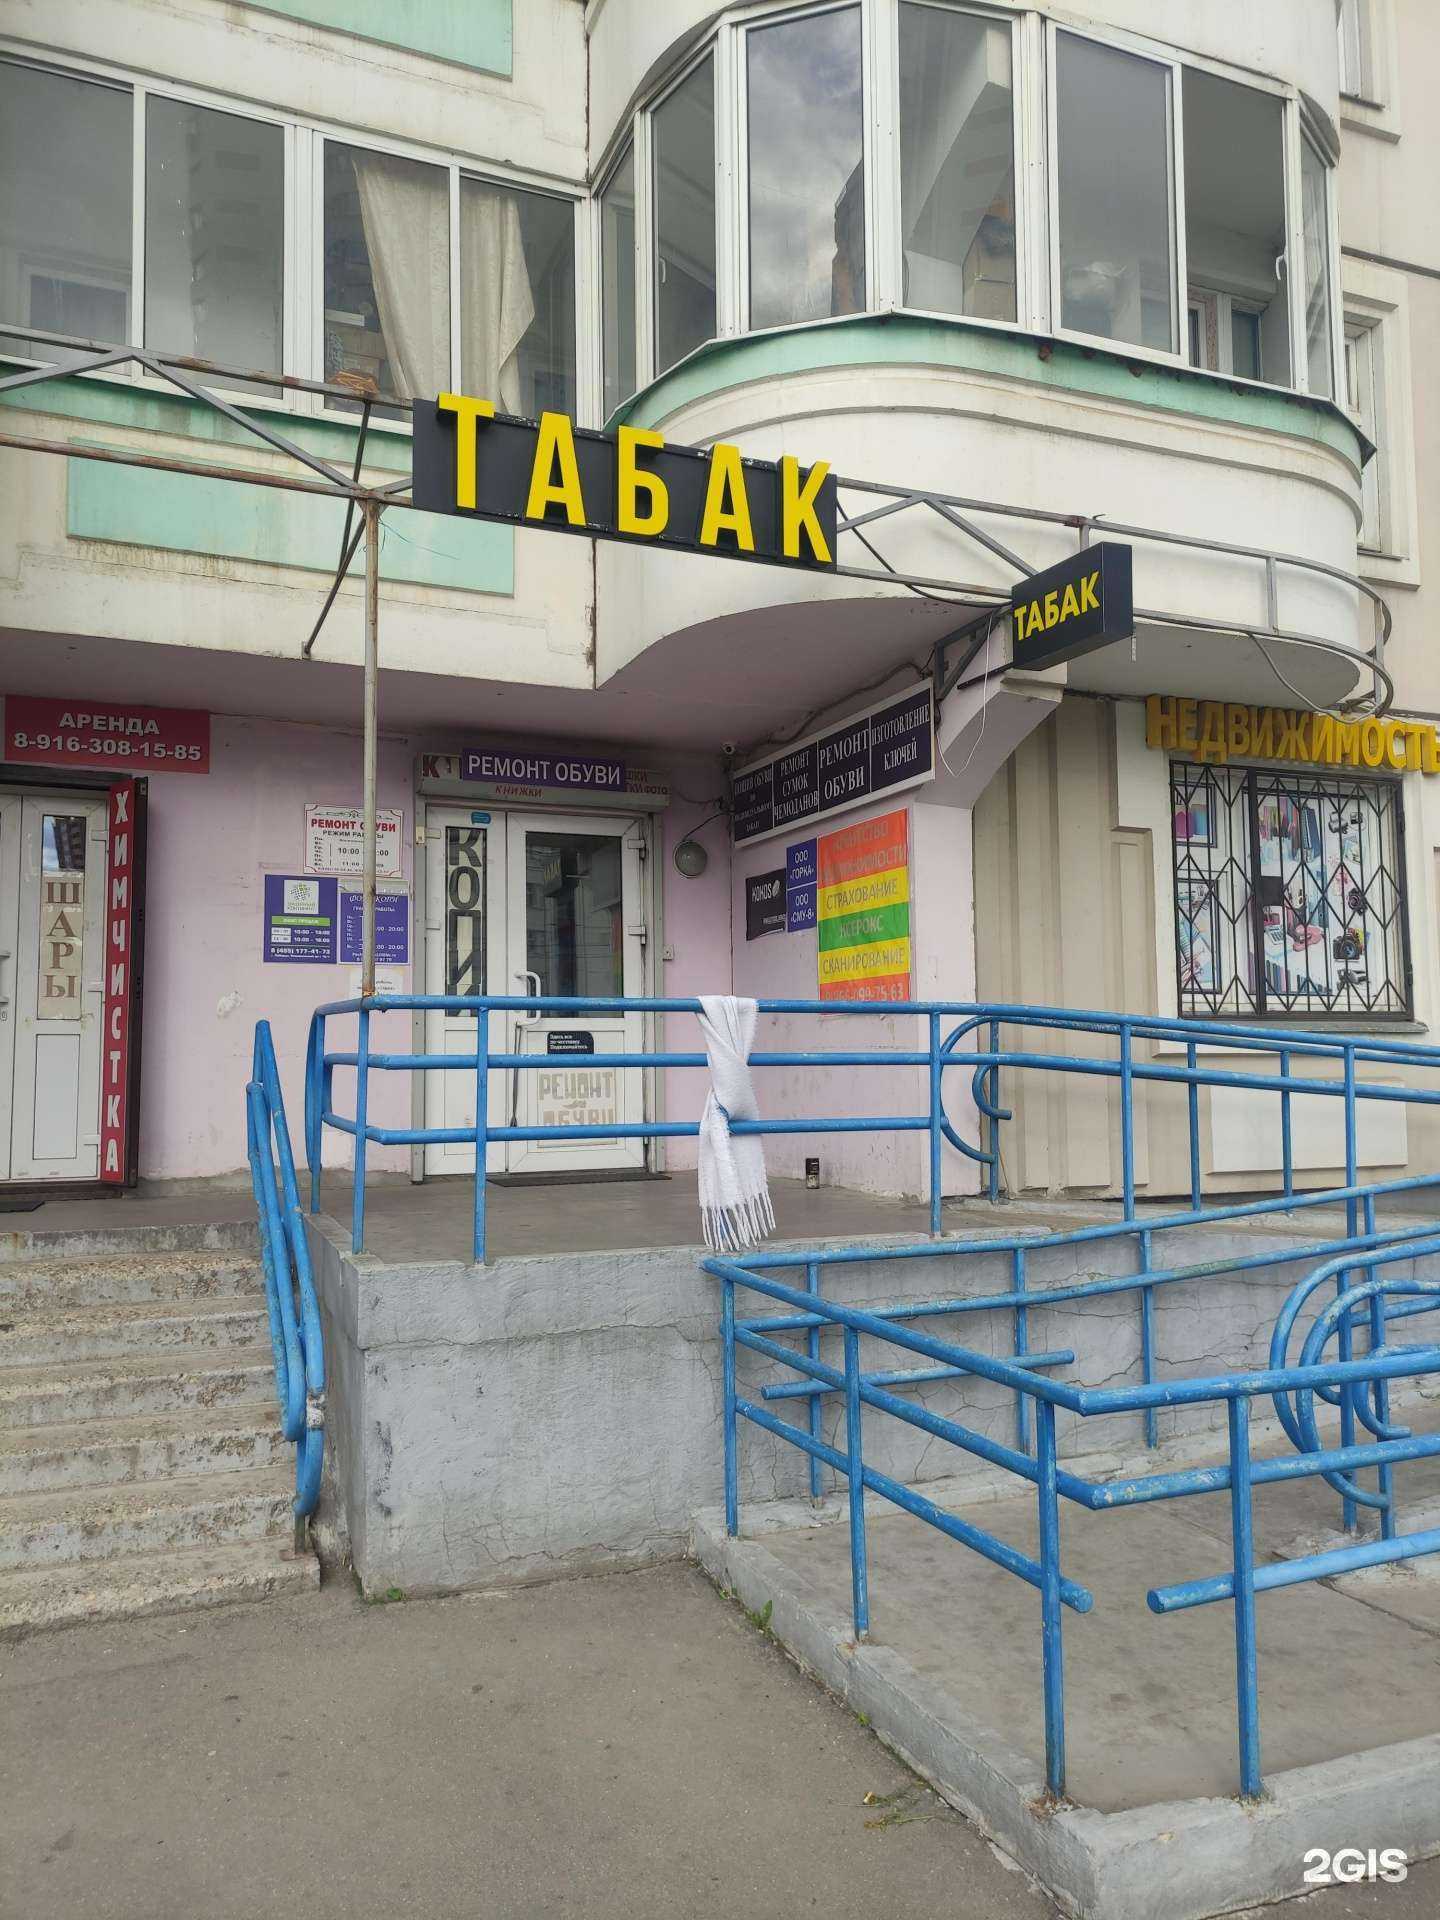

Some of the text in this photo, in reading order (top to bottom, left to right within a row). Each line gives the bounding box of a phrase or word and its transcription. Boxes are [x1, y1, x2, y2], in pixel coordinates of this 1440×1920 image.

[437, 393, 832, 563] ТАБАК
[1013, 571, 1101, 641] ТАБАК
[58, 712, 160, 736] АРЕНДА
[871, 703, 930, 746] ИЗГОТОВЛЕНИЕ
[1145, 695, 1440, 774] НЕДВИЖИМОСТЬ
[13, 732, 202, 761] 8-916-308-15-85
[819, 729, 870, 769] РЕМОНТ
[883, 737, 918, 771] КЛЮЧЕЙ
[468, 755, 621, 785] РЕМОНТ ОБУВИ
[780, 750, 809, 777] РЕМОНТ
[782, 773, 809, 797] СУМОК
[824, 766, 865, 800] ОБУВИ
[773, 790, 818, 821] ЧЕМОДАНОВ
[311, 819, 396, 833] РЕМОНТ УВИ
[794, 849, 809, 864] ООО
[795, 892, 809, 906] ООО
[826, 878, 899, 910] СТРАХОВАНИЕ
[43, 881, 81, 998] ШАРЫ
[840, 914, 885, 937] КСЕРОКС
[822, 947, 905, 976] СКАНИРОВАНИЕ
[105, 790, 130, 1173] ХИМЧИСТКА
